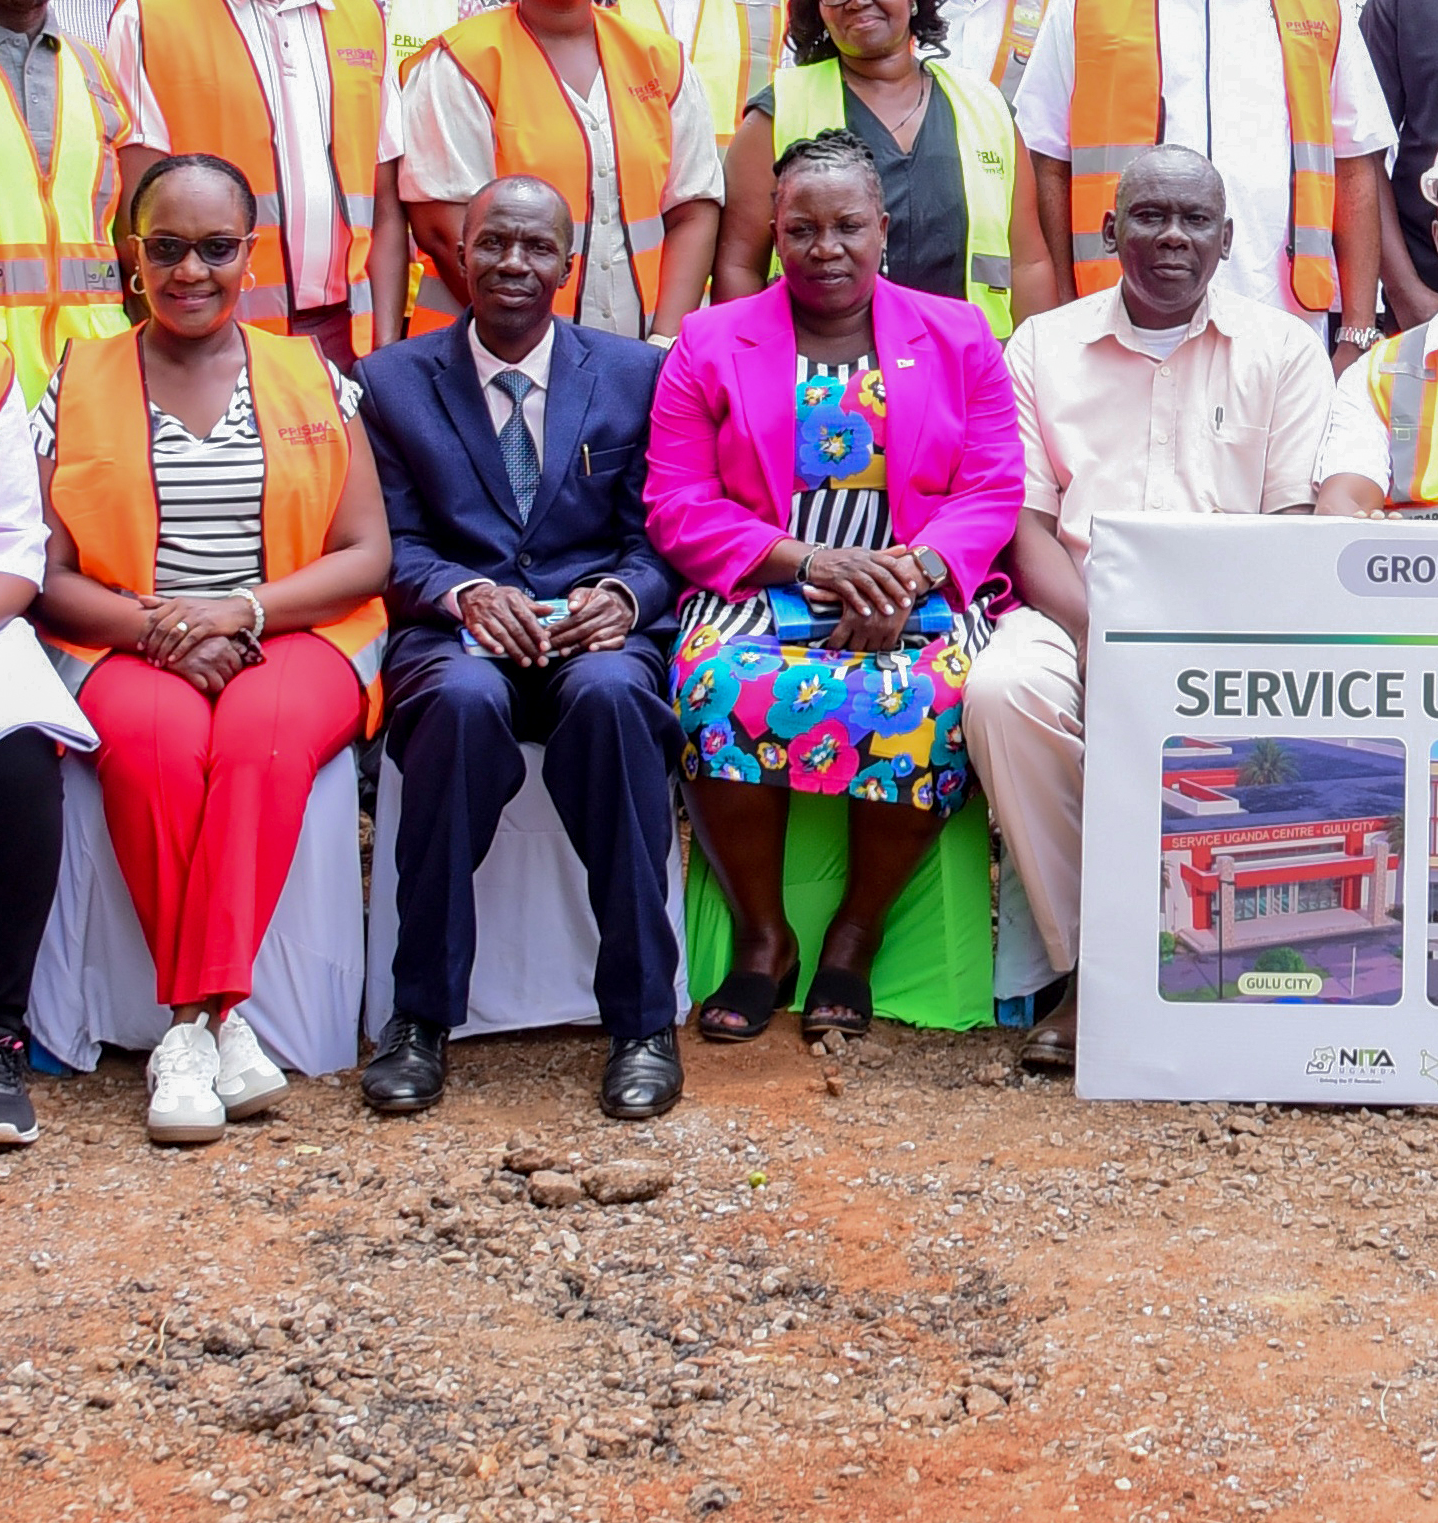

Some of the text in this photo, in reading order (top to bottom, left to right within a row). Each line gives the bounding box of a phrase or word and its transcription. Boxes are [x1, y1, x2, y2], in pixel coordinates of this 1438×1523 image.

[394, 34, 423, 46] PRIS
[1174, 668, 1406, 718] SERVICE
[1171, 833, 1221, 849] SERVICE
[1223, 829, 1270, 844] UGANDA
[1271, 825, 1315, 840] CENTRE
[1322, 822, 1351, 835] GULU
[1351, 819, 1375, 833] CITY
[1246, 977, 1313, 990] GULU CITY
[1340, 1048, 1395, 1067] NITA
